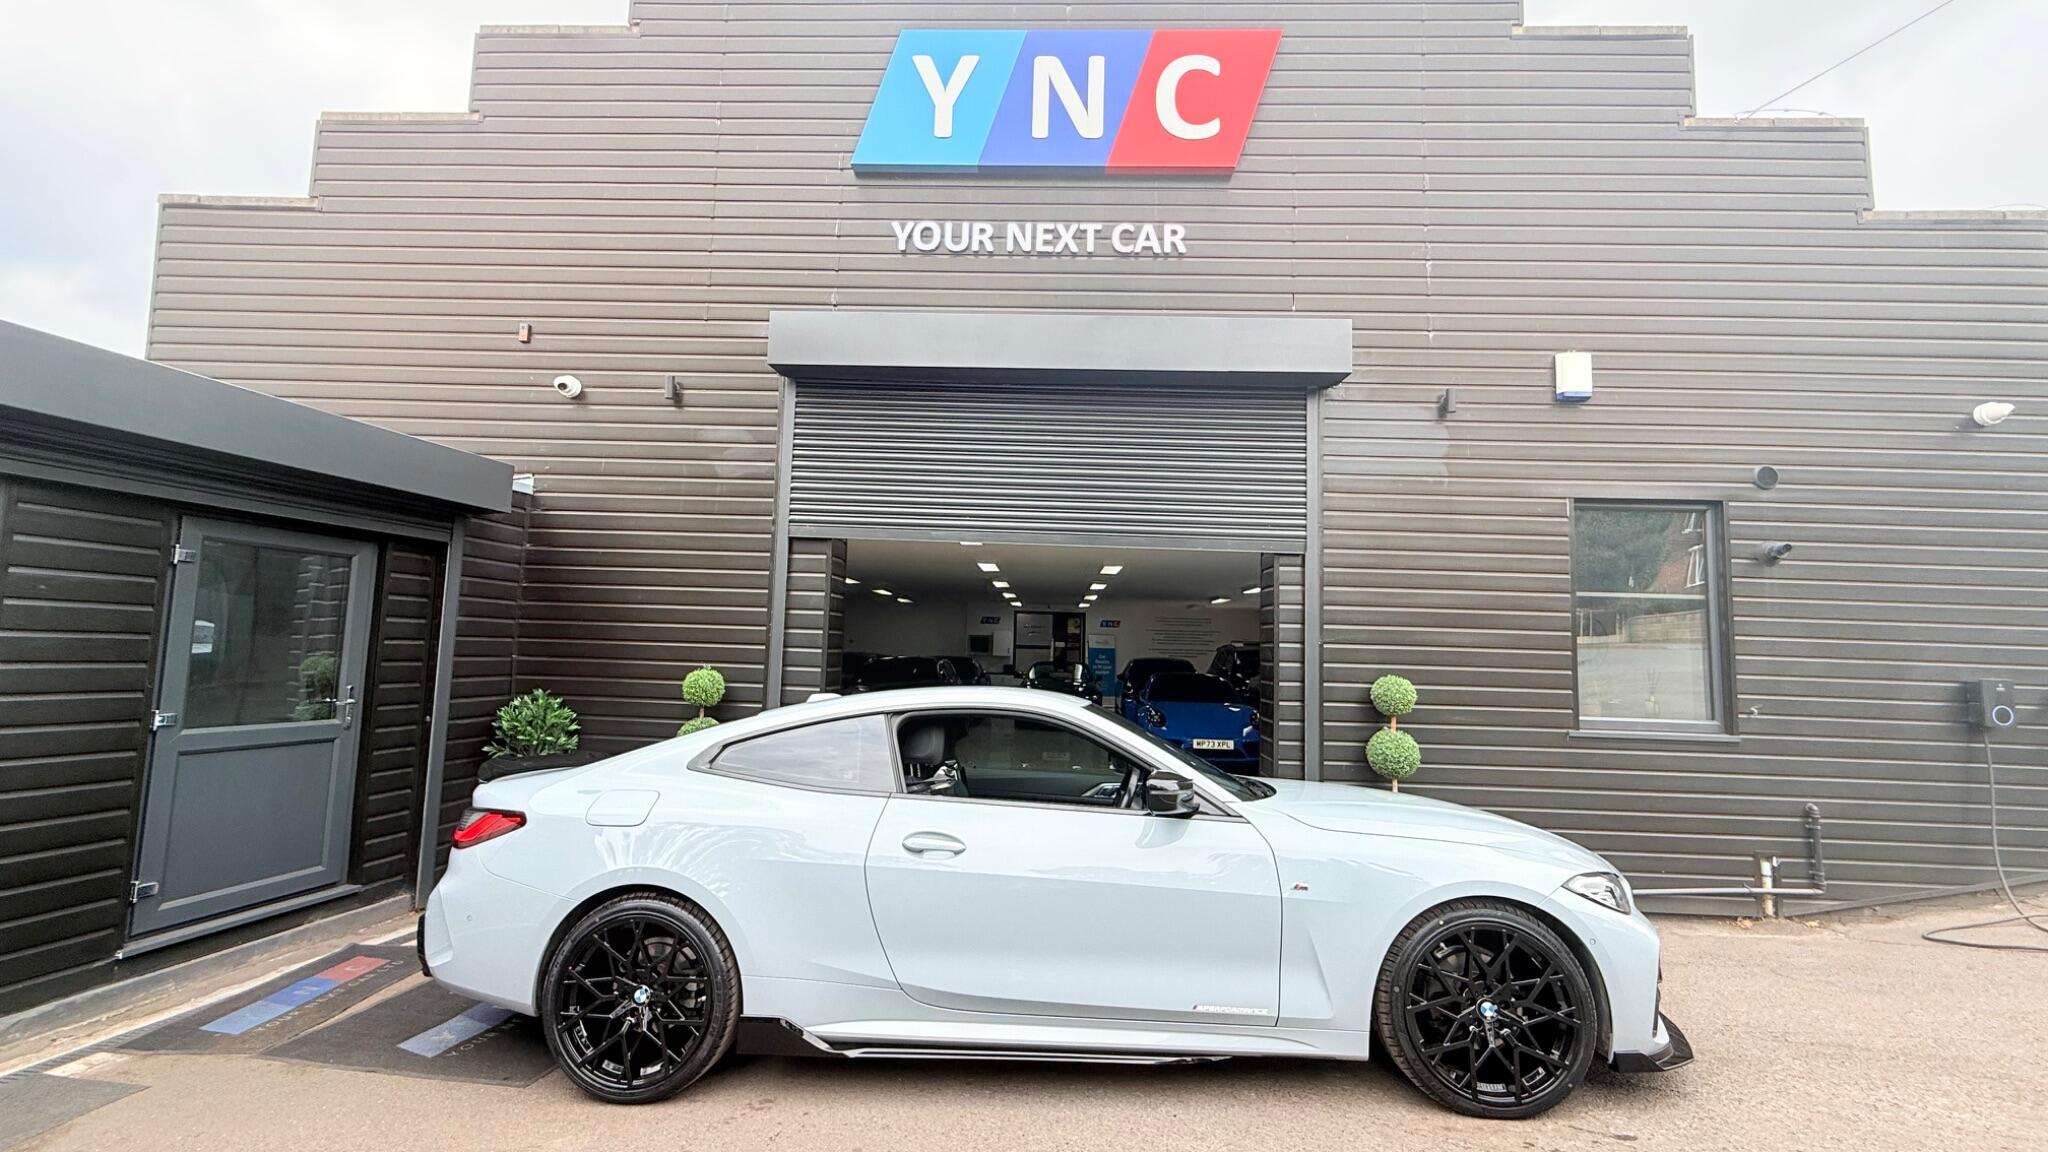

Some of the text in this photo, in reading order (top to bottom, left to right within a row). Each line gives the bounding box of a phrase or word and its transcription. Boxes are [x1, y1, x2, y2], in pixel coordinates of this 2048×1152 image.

[911, 54, 1222, 140] YNC
[890, 221, 1188, 255] YOUR NEXT CAR
